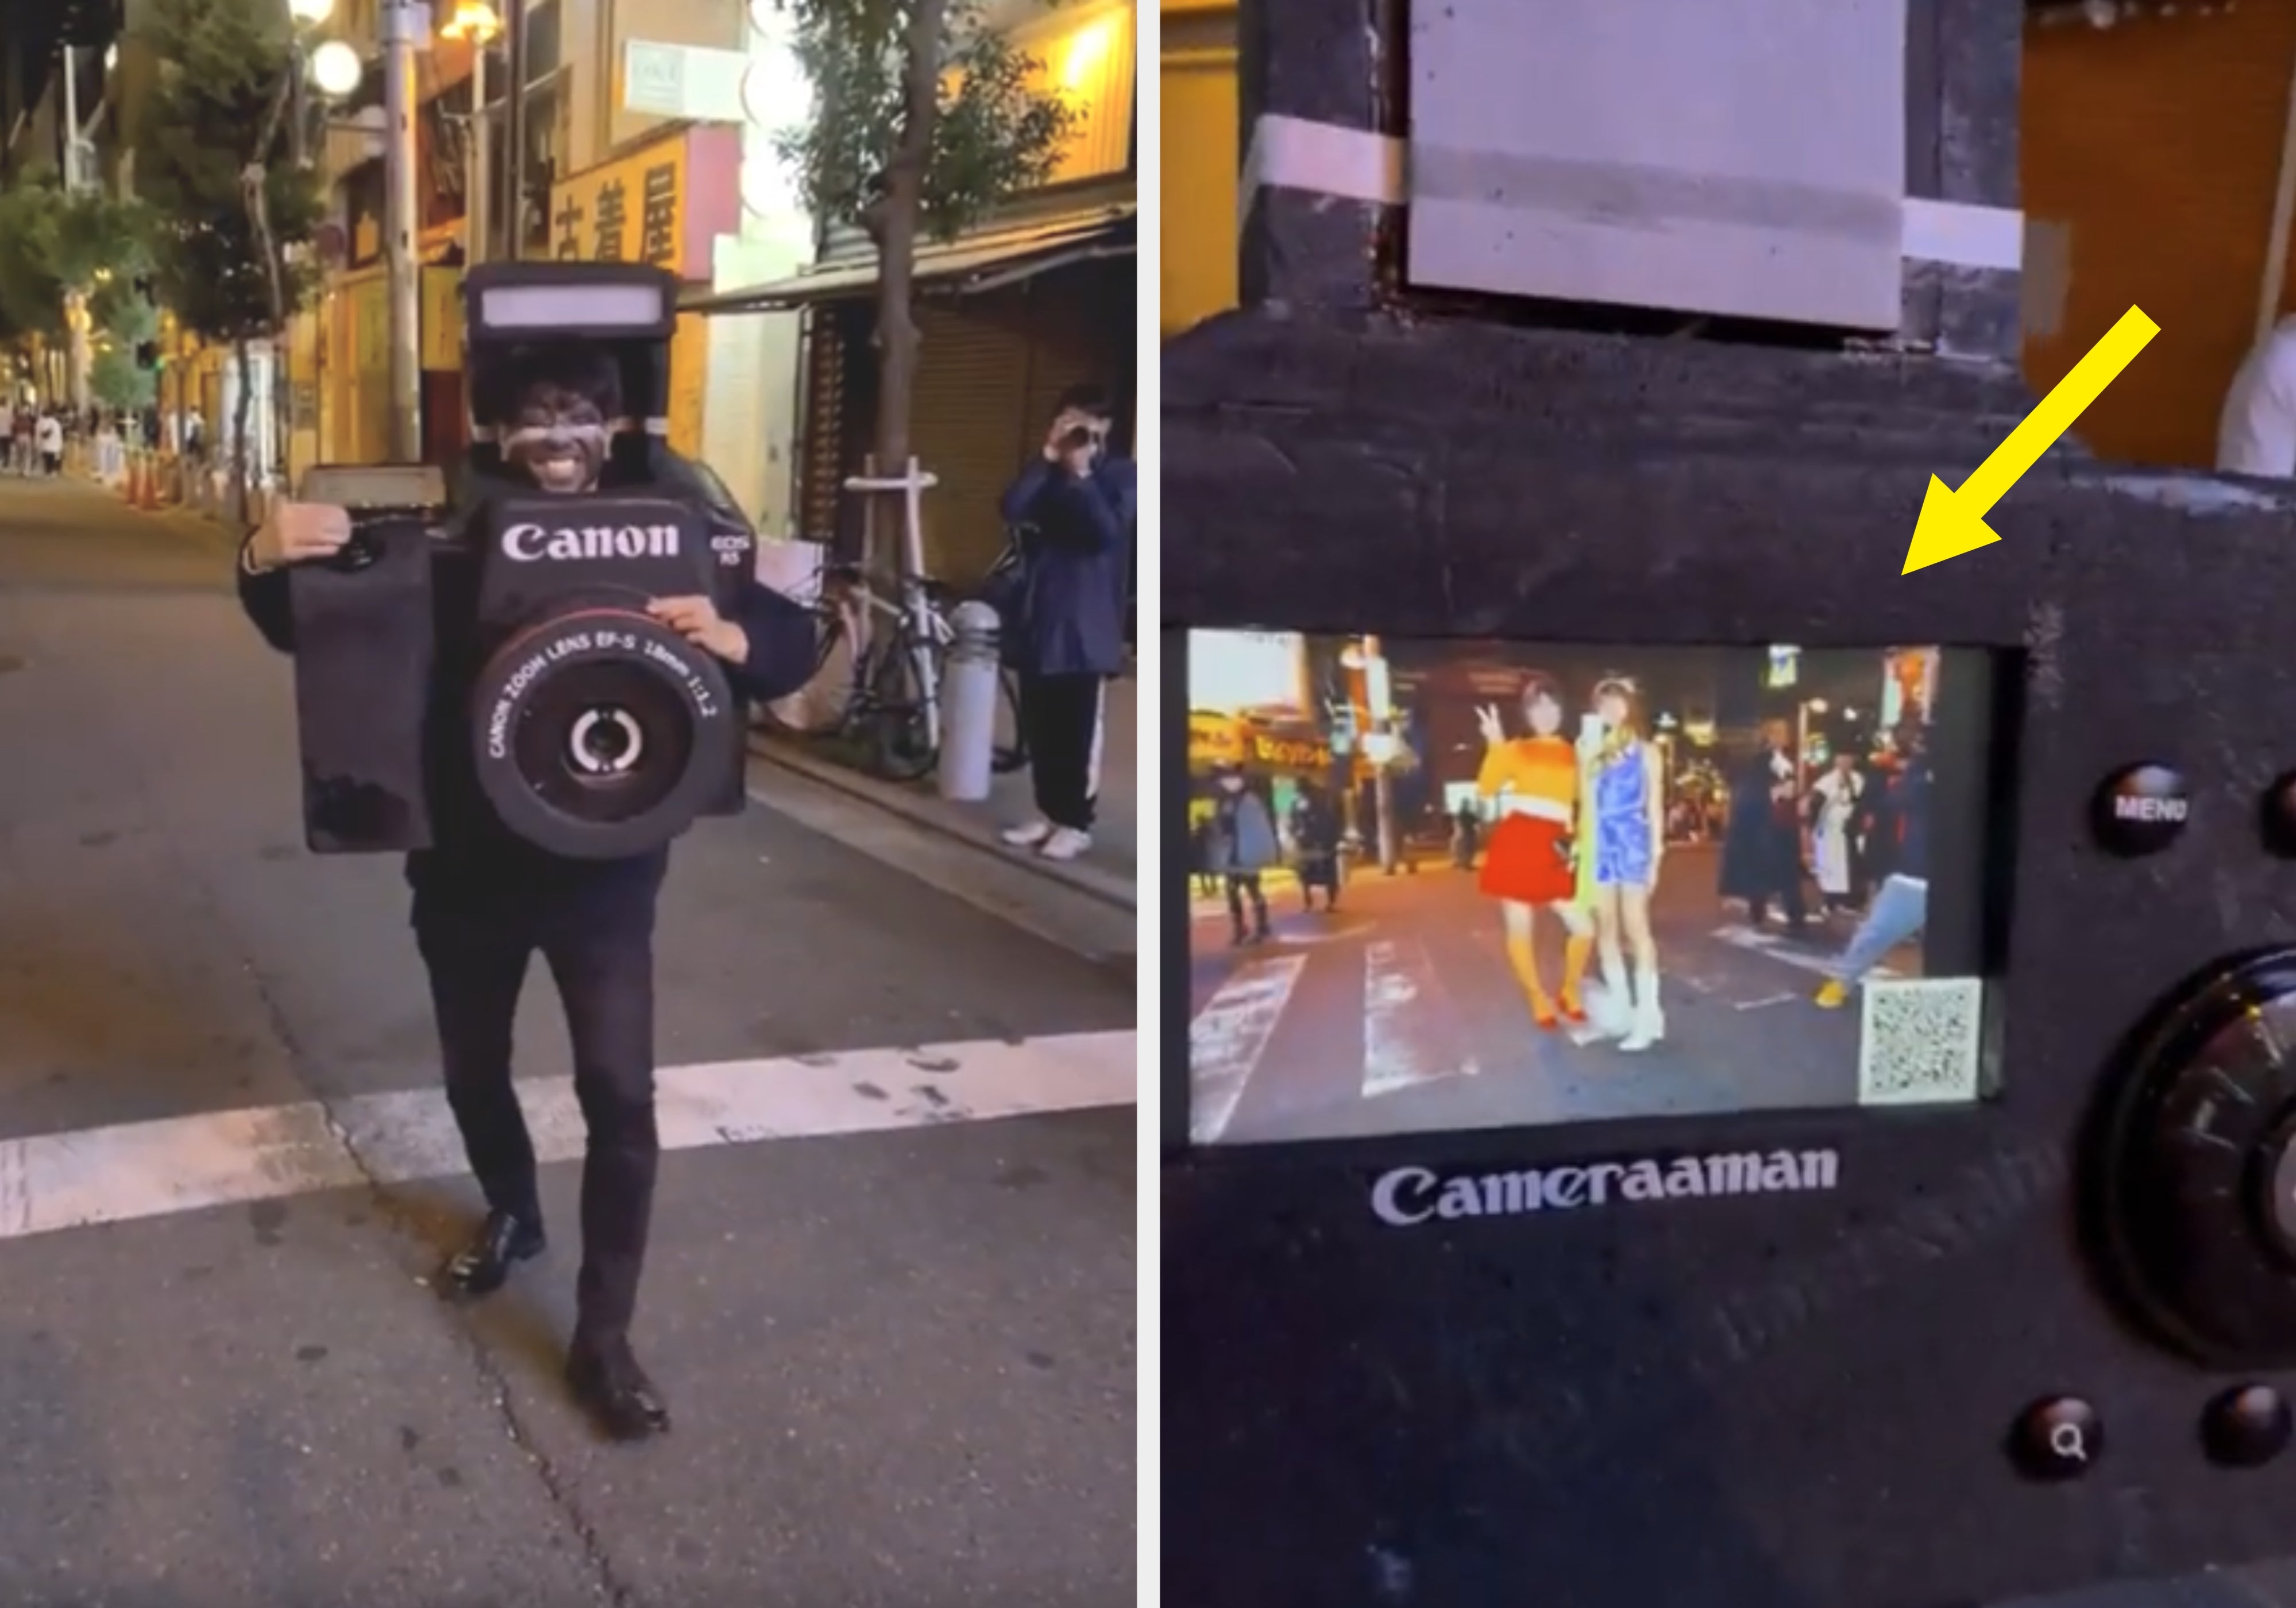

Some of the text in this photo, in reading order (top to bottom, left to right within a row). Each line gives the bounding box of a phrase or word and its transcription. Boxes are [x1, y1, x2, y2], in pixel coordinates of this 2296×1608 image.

[501, 523, 680, 561] Canon
[489, 699, 511, 759] CANON
[546, 633, 591, 660] LENS
[596, 631, 635, 650] EF-S
[1372, 1148, 1839, 1224] Cameraaman
